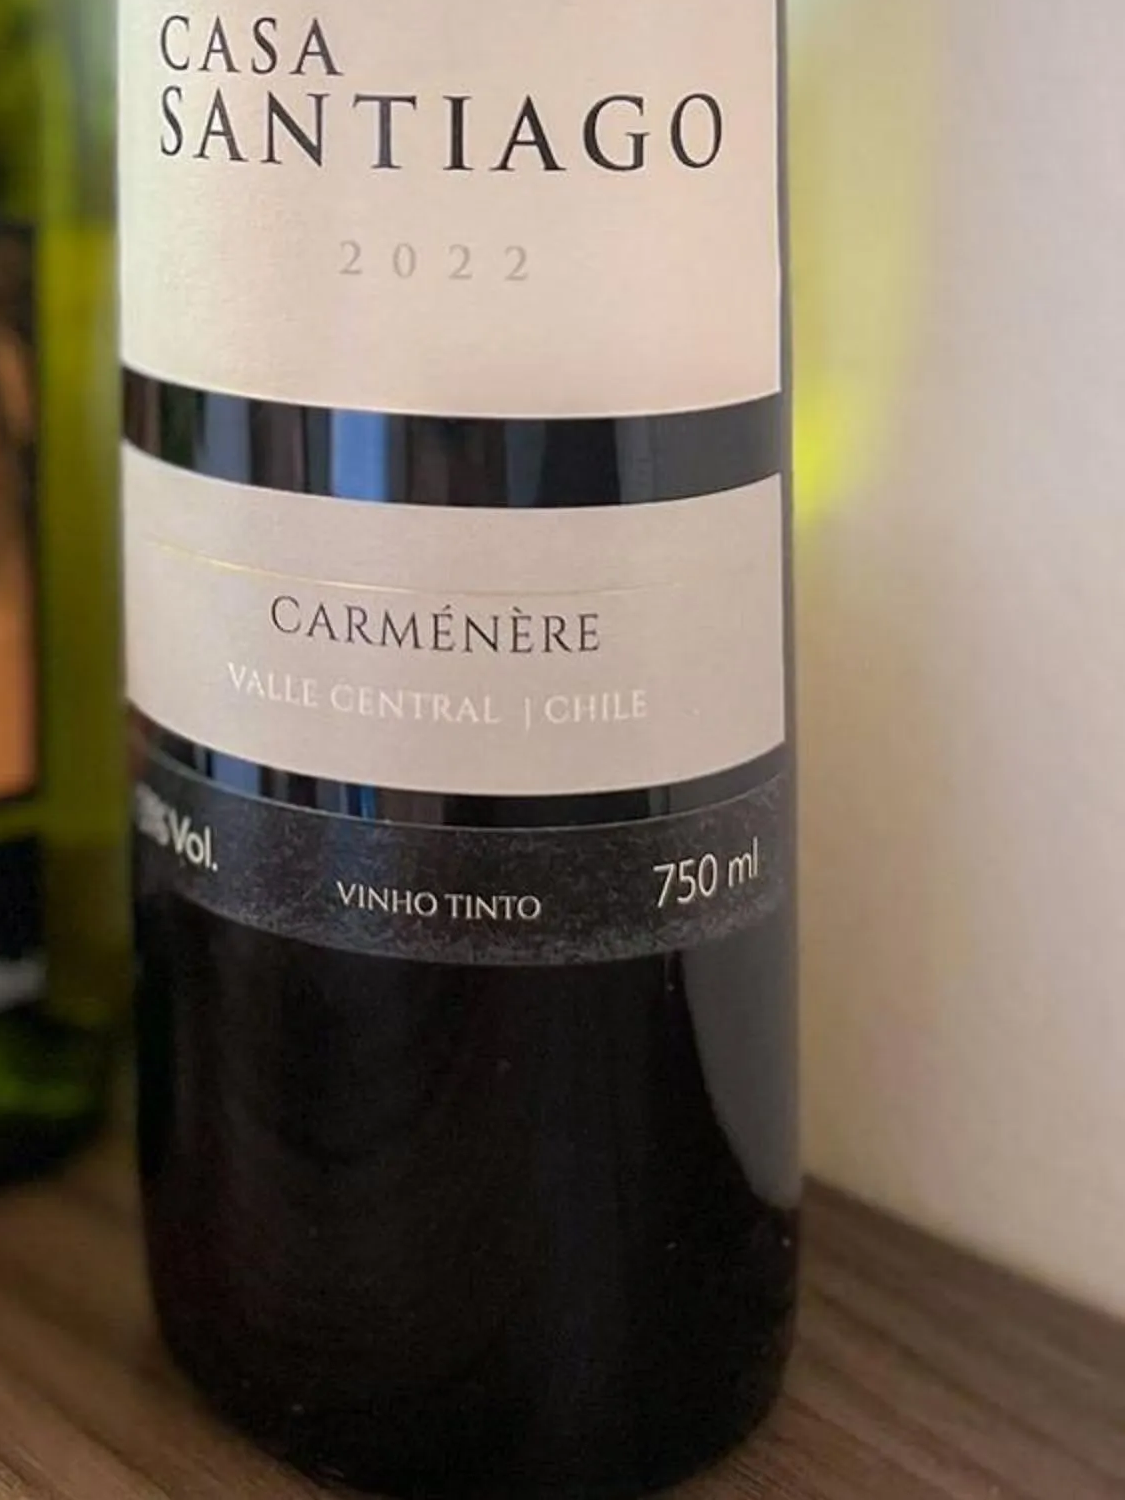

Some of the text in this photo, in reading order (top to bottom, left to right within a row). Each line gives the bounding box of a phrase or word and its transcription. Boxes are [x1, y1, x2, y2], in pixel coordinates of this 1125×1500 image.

[160, 15, 343, 76] CASA
[160, 85, 723, 172] SANTIAGO
[338, 240, 529, 281] 2022
[270, 595, 601, 654] CARMÉNÈRE
[227, 662, 647, 725] VALLE CENTRAL CHILE
[336, 881, 542, 921] VINHO TINTO
[653, 837, 759, 908] 750 ml
